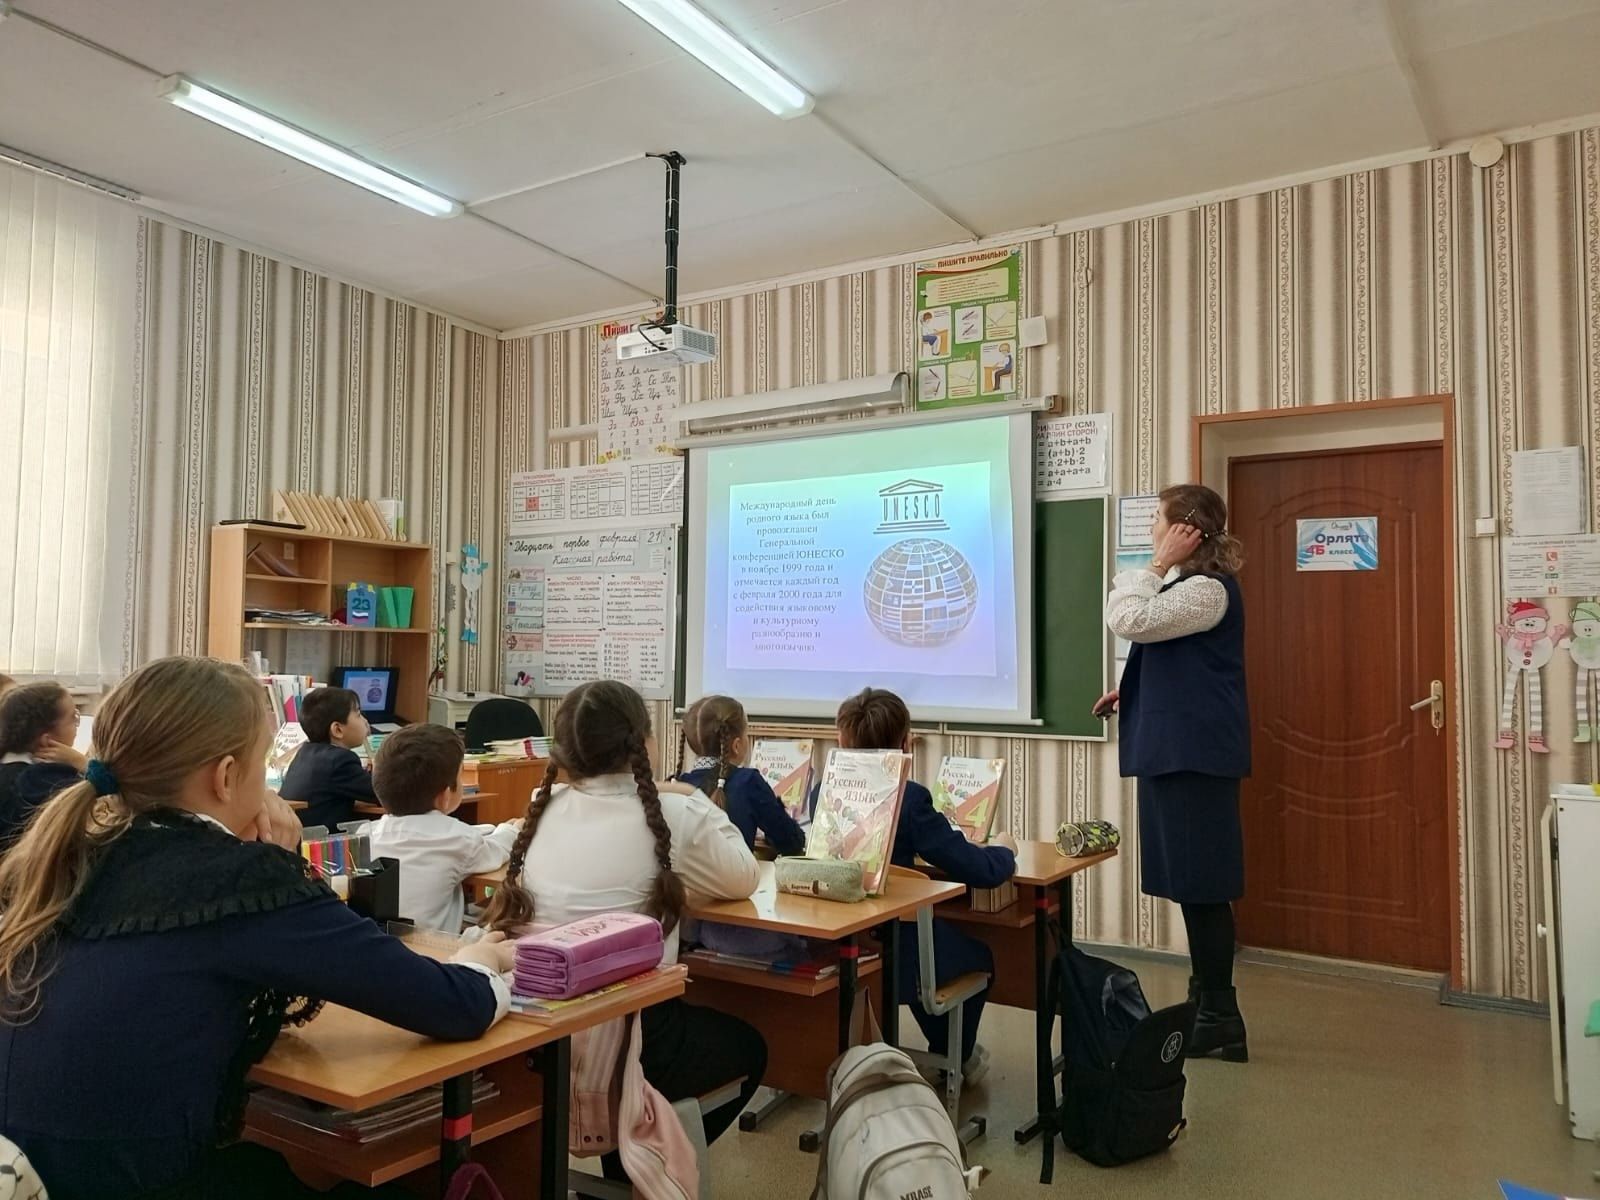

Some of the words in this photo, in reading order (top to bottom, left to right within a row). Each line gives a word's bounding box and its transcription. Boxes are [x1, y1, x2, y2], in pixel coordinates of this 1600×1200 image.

[938, 257, 967, 268] ПИШИТЕ
[967, 249, 1009, 263] ПРАВИЛЬНО
[740, 498, 813, 511] Международный
[815, 497, 837, 507] день
[883, 493, 940, 521] UNESCO
[746, 515, 781, 526] родного
[783, 513, 810, 521] языка
[811, 510, 830, 520] был
[647, 531, 661, 543] 21
[759, 537, 815, 549] Генеральной
[732, 551, 794, 563] конференцией
[796, 549, 845, 559] ЮНЕСКО
[1305, 544, 1326, 556] 4Б
[552, 554, 592, 565] Кланая
[748, 564, 779, 576] ноябре
[782, 563, 802, 573] 1999
[804, 563, 825, 573] года
[734, 579, 783, 587] отмечается
[785, 576, 820, 586] каждый
[822, 577, 840, 586] год
[739, 590, 776, 601] февраля
[778, 590, 800, 599] 2000
[802, 591, 826, 599] года
[825, 590, 842, 599] для
[351, 597, 371, 611] 23
[735, 603, 785, 613] содействия
[787, 604, 837, 614] языковому
[760, 617, 820, 628] культурному
[826, 772, 867, 789] Русский
[964, 797, 990, 828] 4
